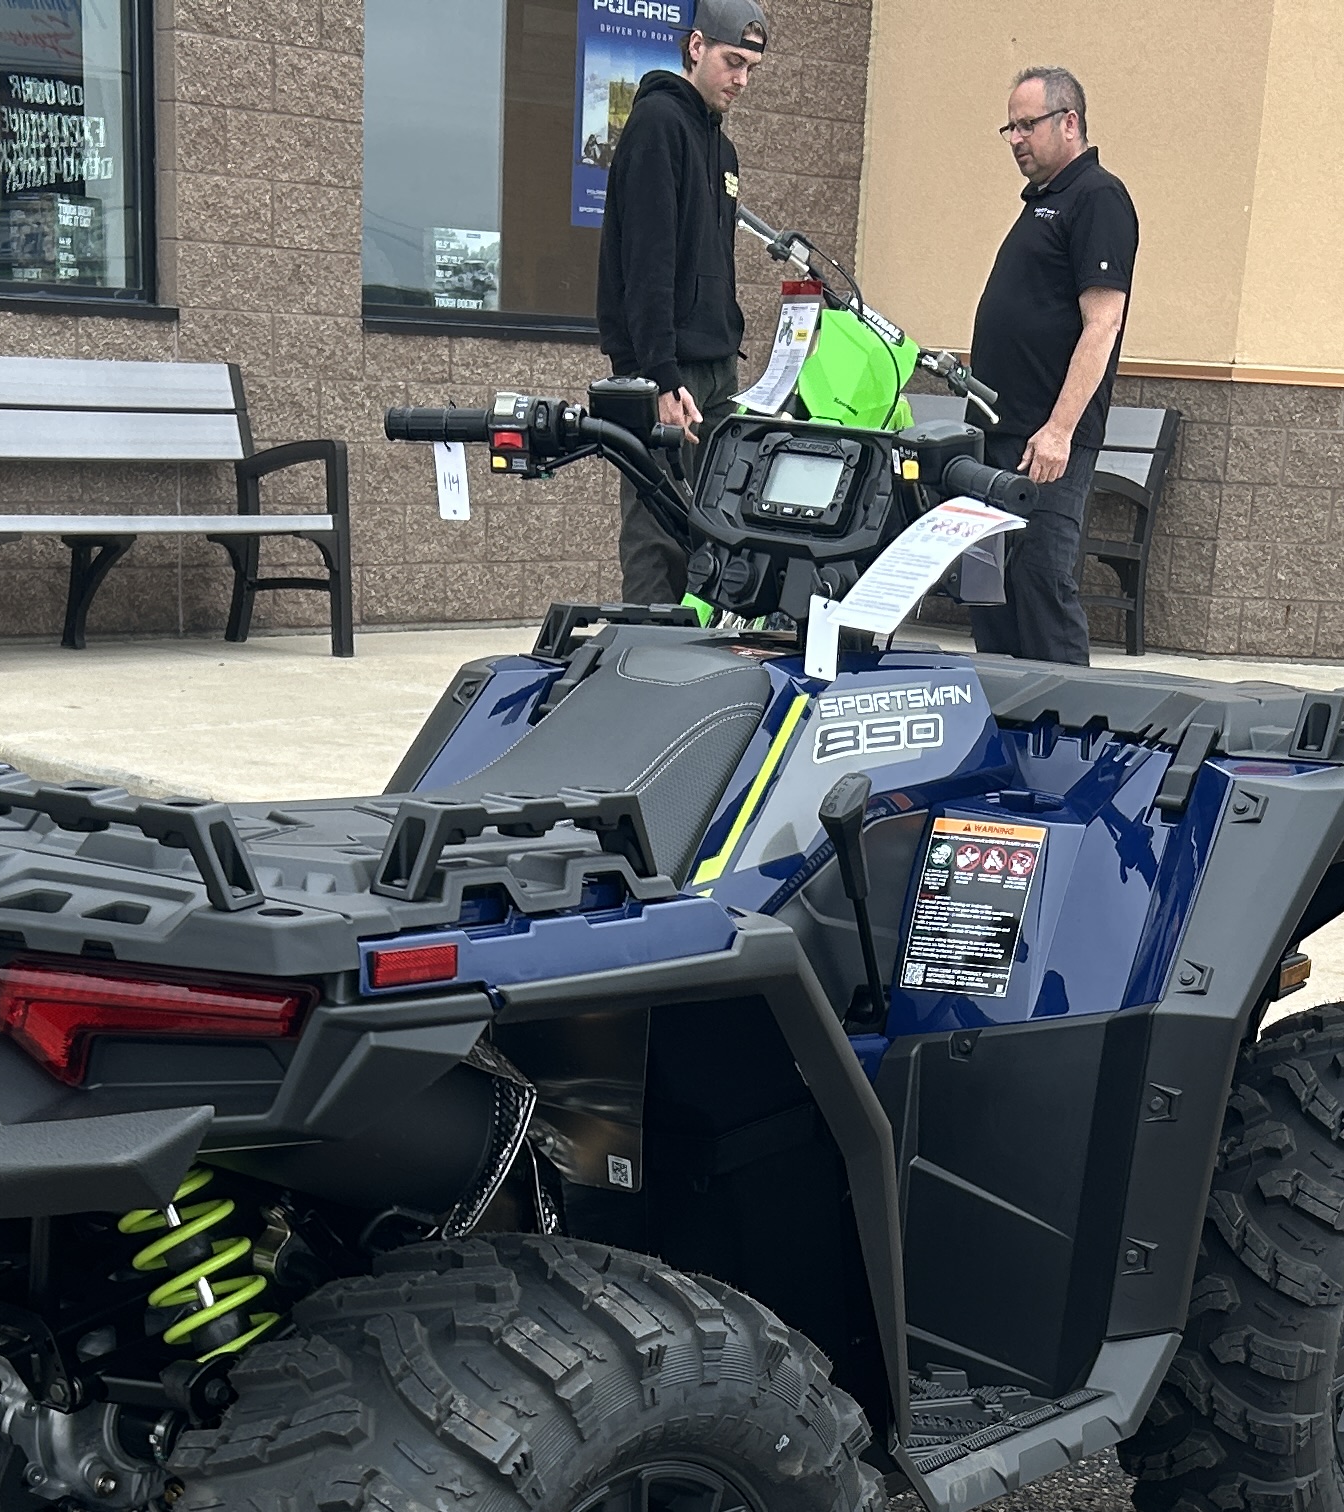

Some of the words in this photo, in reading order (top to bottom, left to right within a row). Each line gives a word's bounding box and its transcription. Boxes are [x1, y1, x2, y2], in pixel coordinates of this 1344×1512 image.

[593, 0, 681, 23] POLARIS
[600, 24, 632, 36] DRIVEN
[637, 29, 647, 38] TO
[651, 31, 674, 42] ROAM
[443, 471, 460, 494] 114
[819, 684, 972, 719] SPORTSMAN
[812, 713, 944, 765] 850
[974, 824, 1015, 836] WARNING
